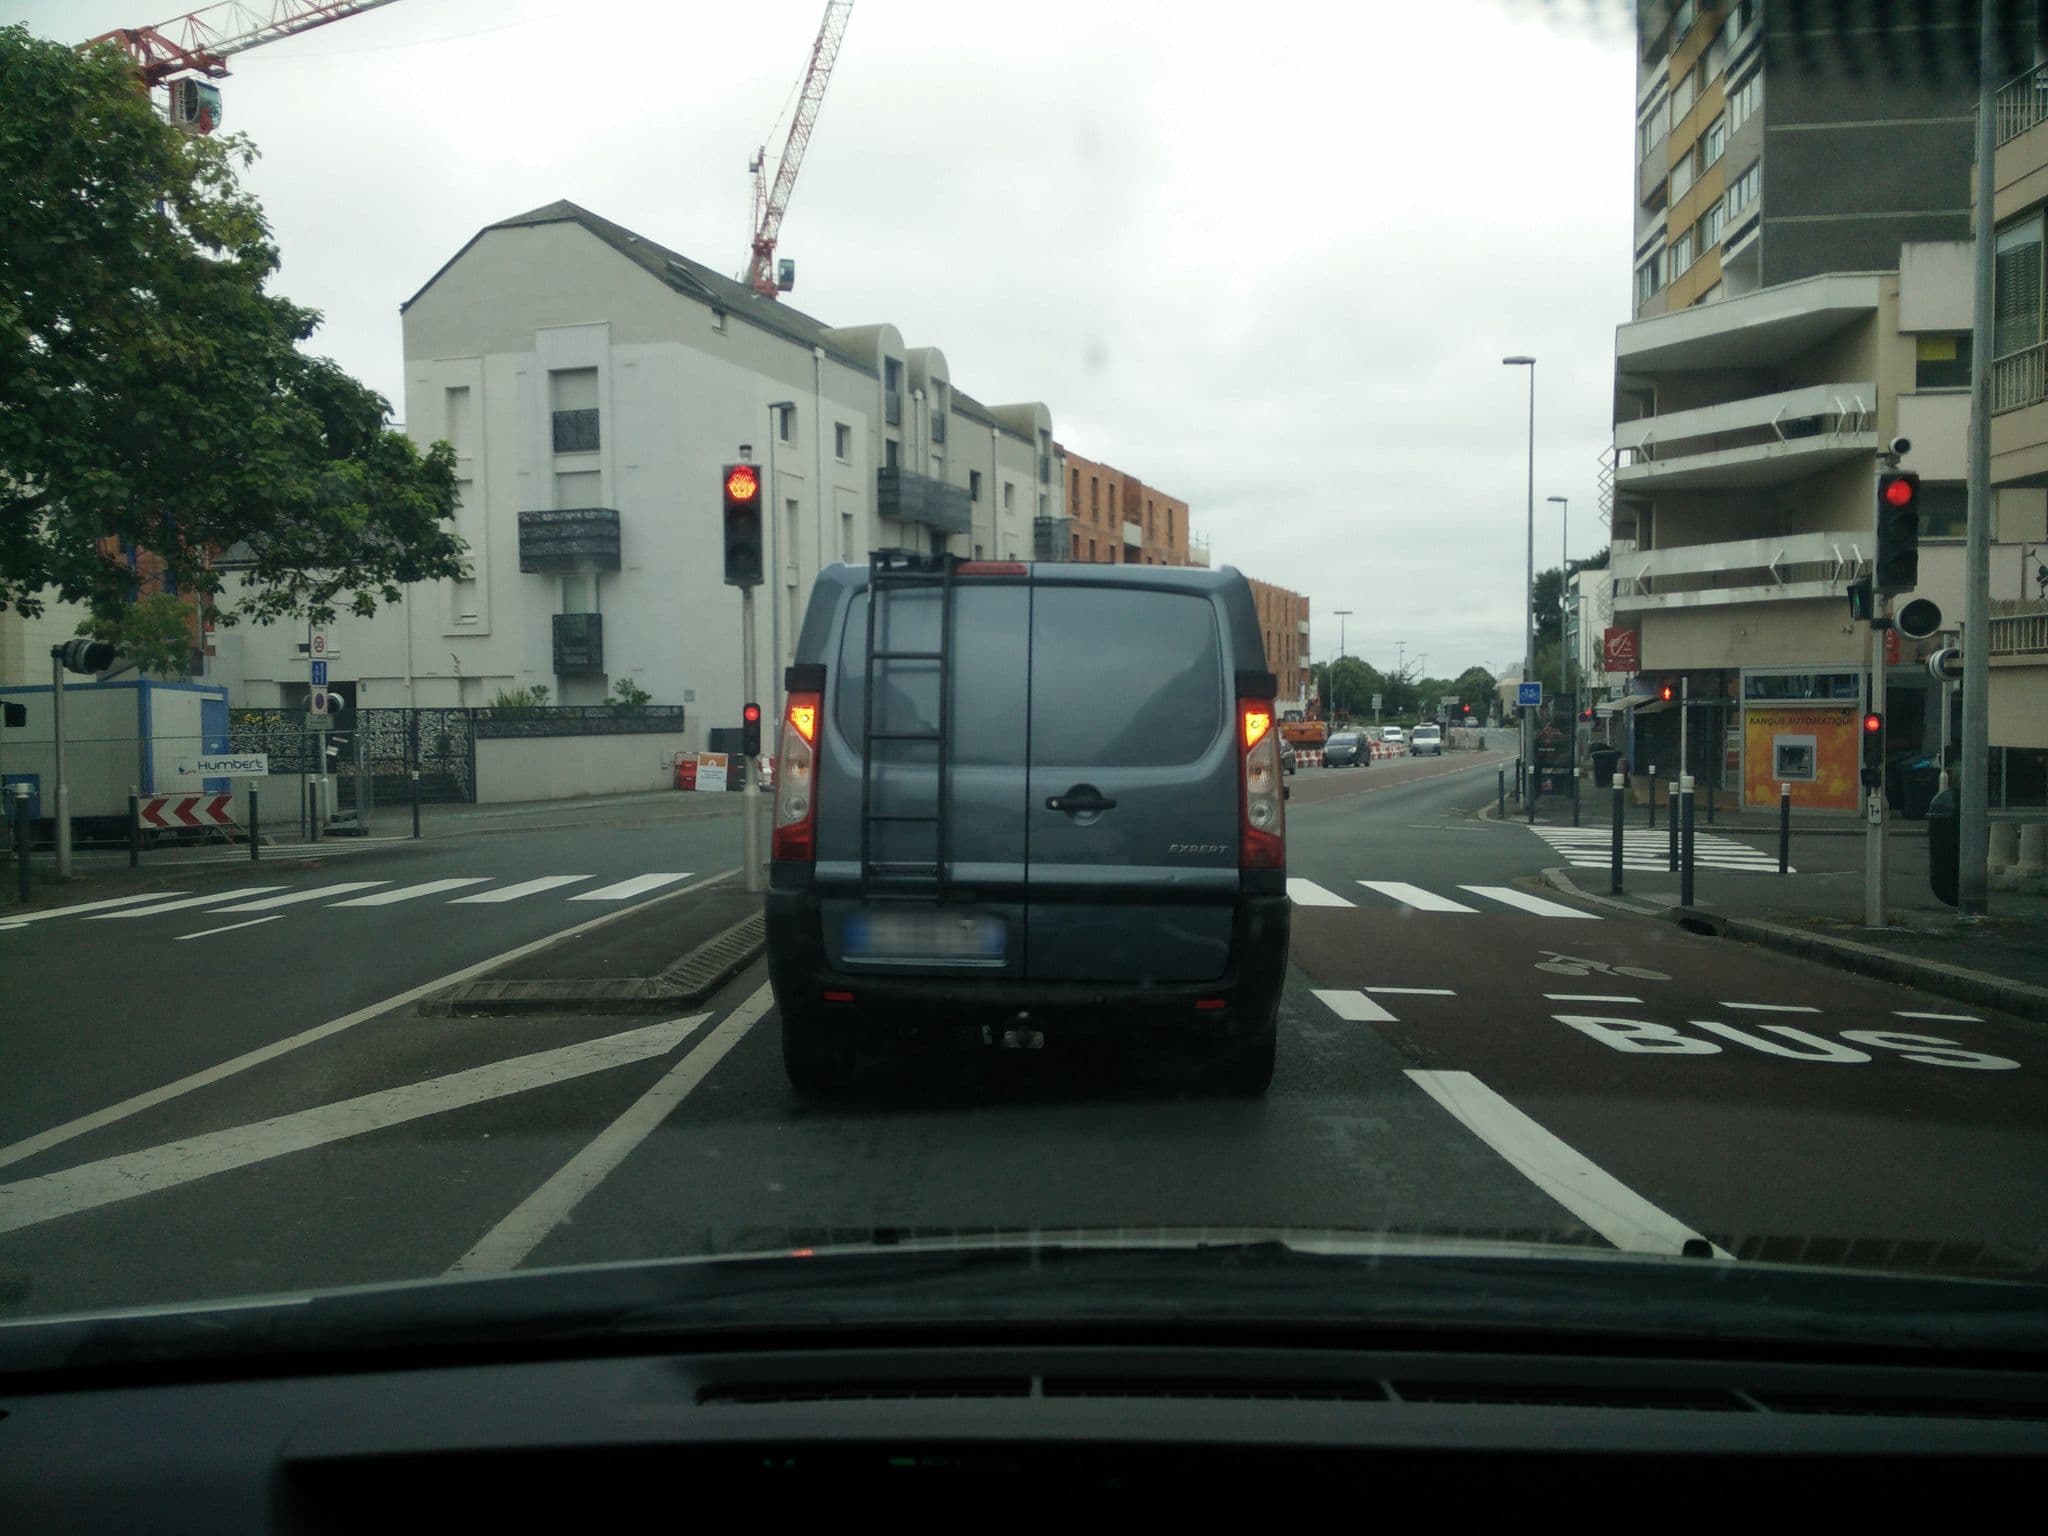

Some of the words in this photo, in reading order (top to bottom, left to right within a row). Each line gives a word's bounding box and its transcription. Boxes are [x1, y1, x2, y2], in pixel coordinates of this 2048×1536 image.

[1749, 717, 1785, 726] BANQUE
[198, 759, 264, 771] Humbert
[1168, 844, 1229, 854] EXPERT
[1551, 1015, 2021, 1071] BUS
